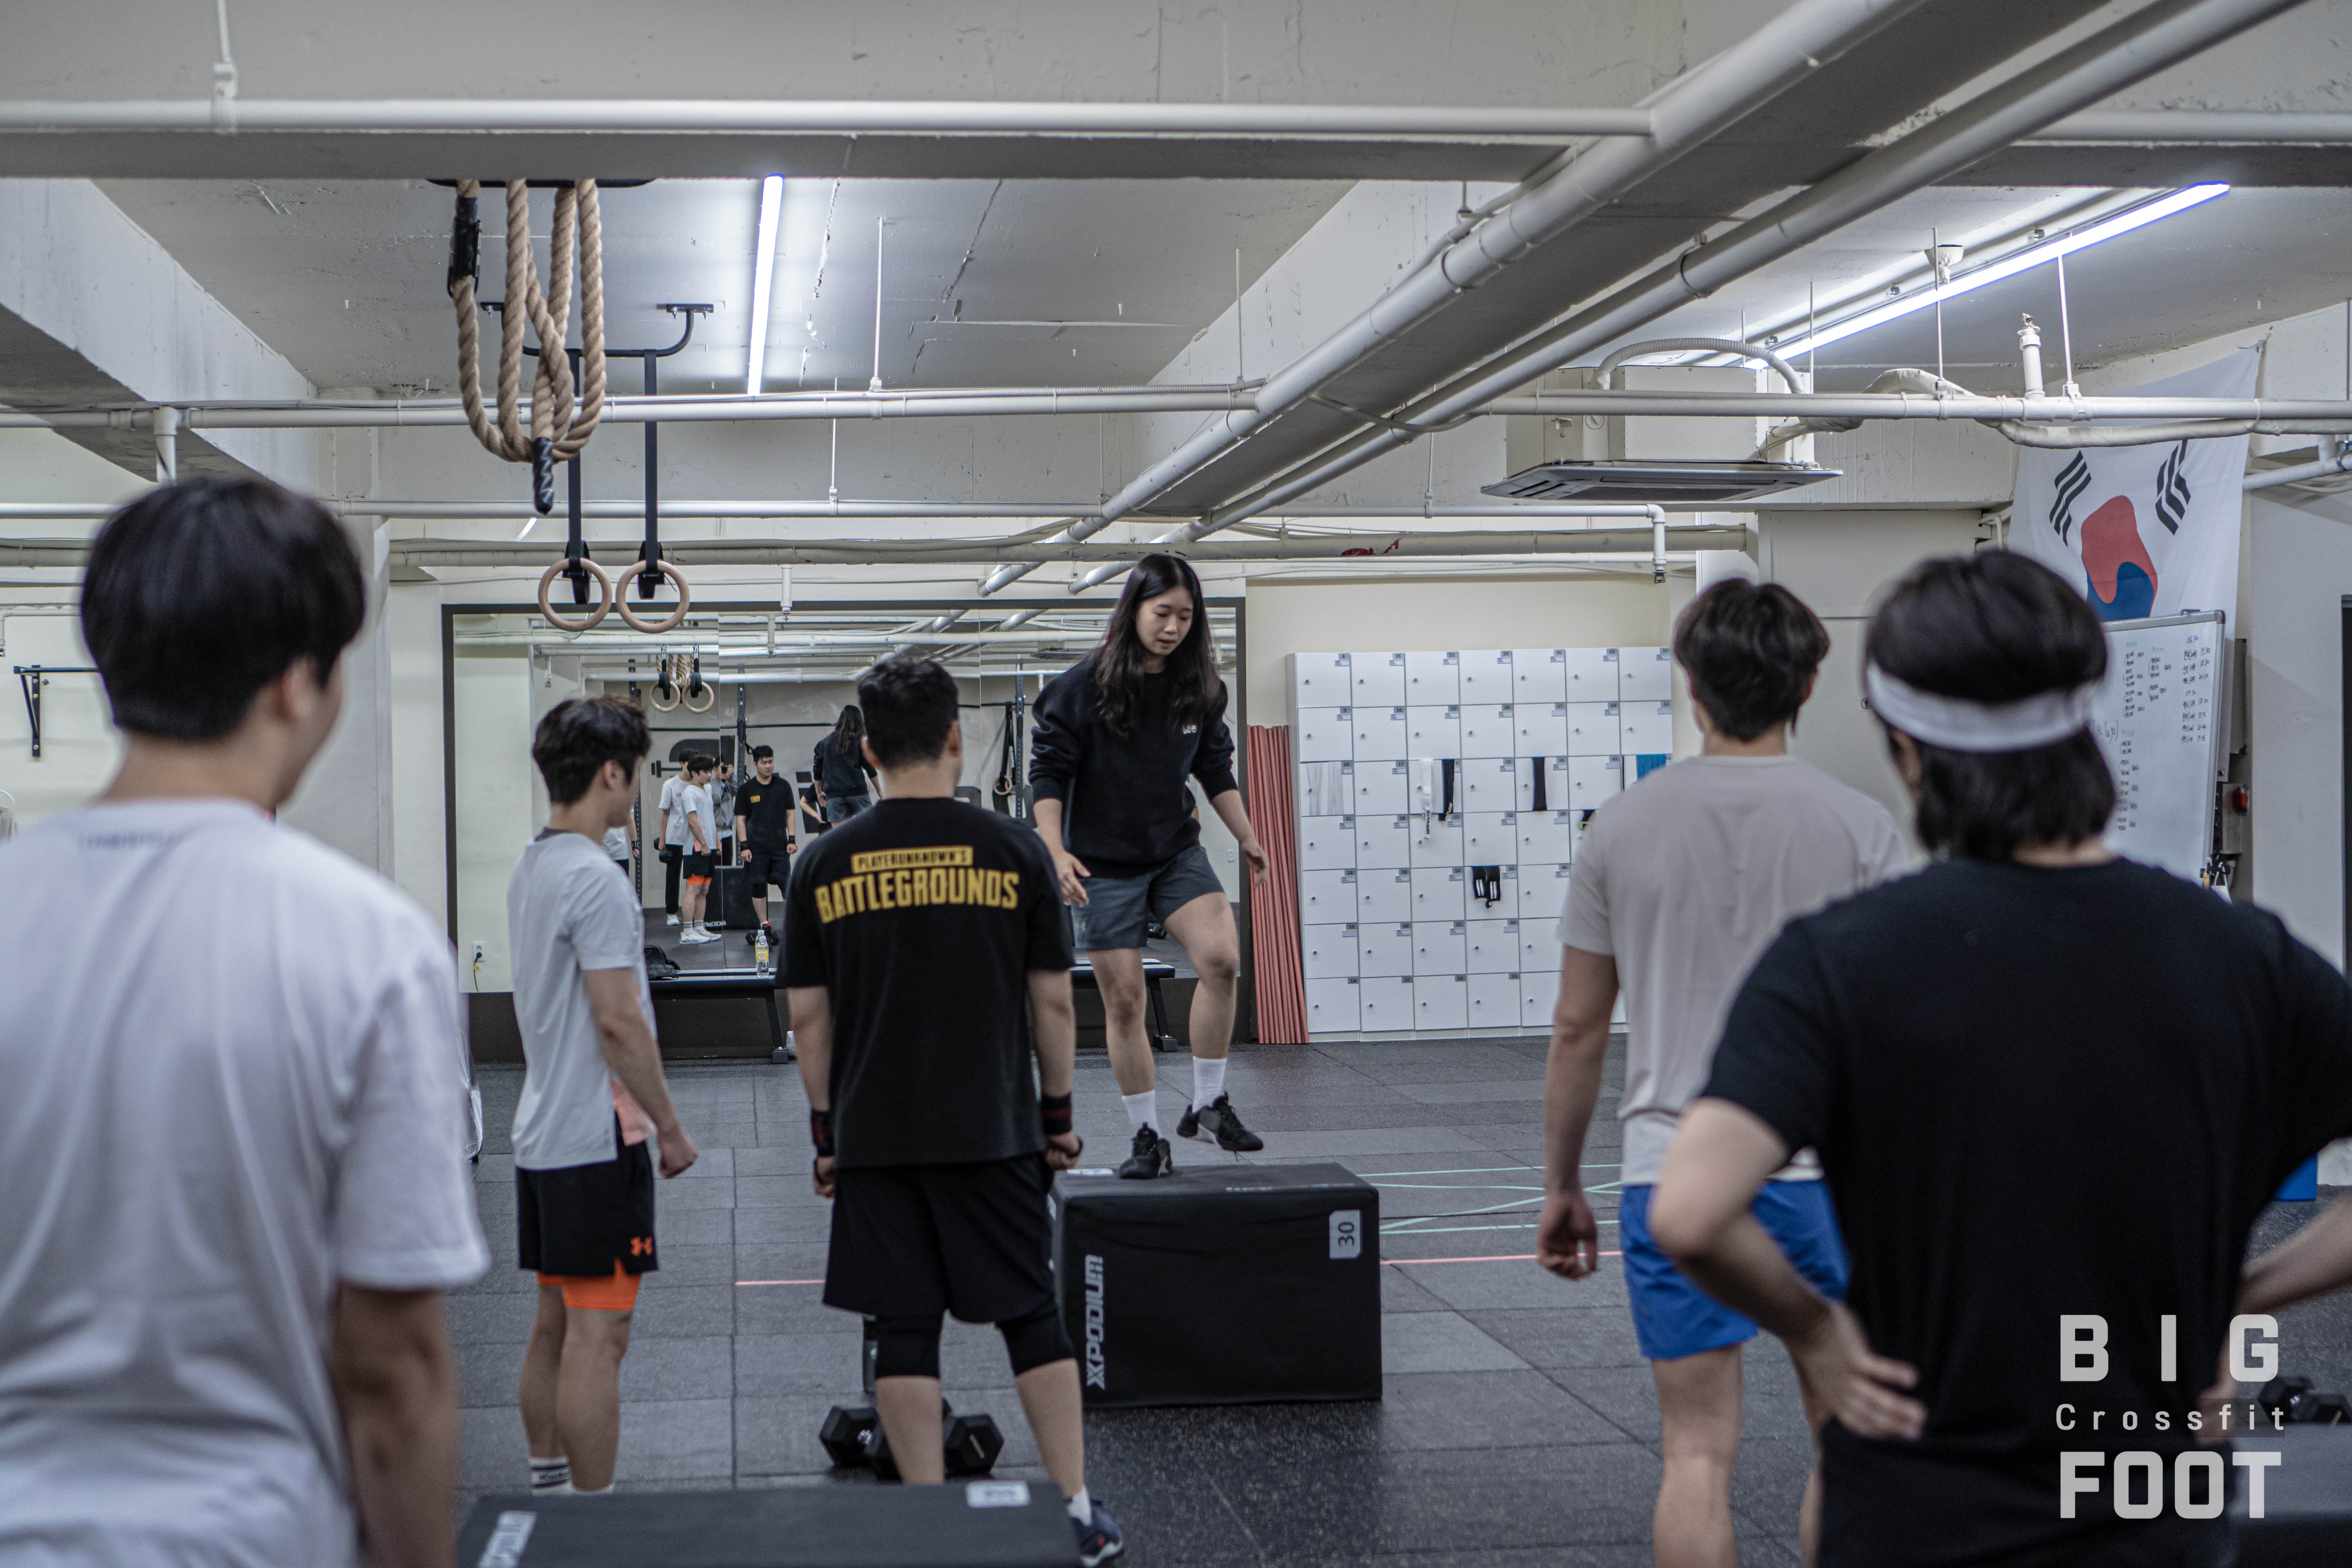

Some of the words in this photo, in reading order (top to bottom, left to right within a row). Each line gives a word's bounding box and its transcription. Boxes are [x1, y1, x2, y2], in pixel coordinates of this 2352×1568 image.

[815, 868, 1019, 924] BATTLEGROUNDS
[1338, 1221, 1355, 1247] 30
[1085, 1254, 1105, 1390] XPODIUM
